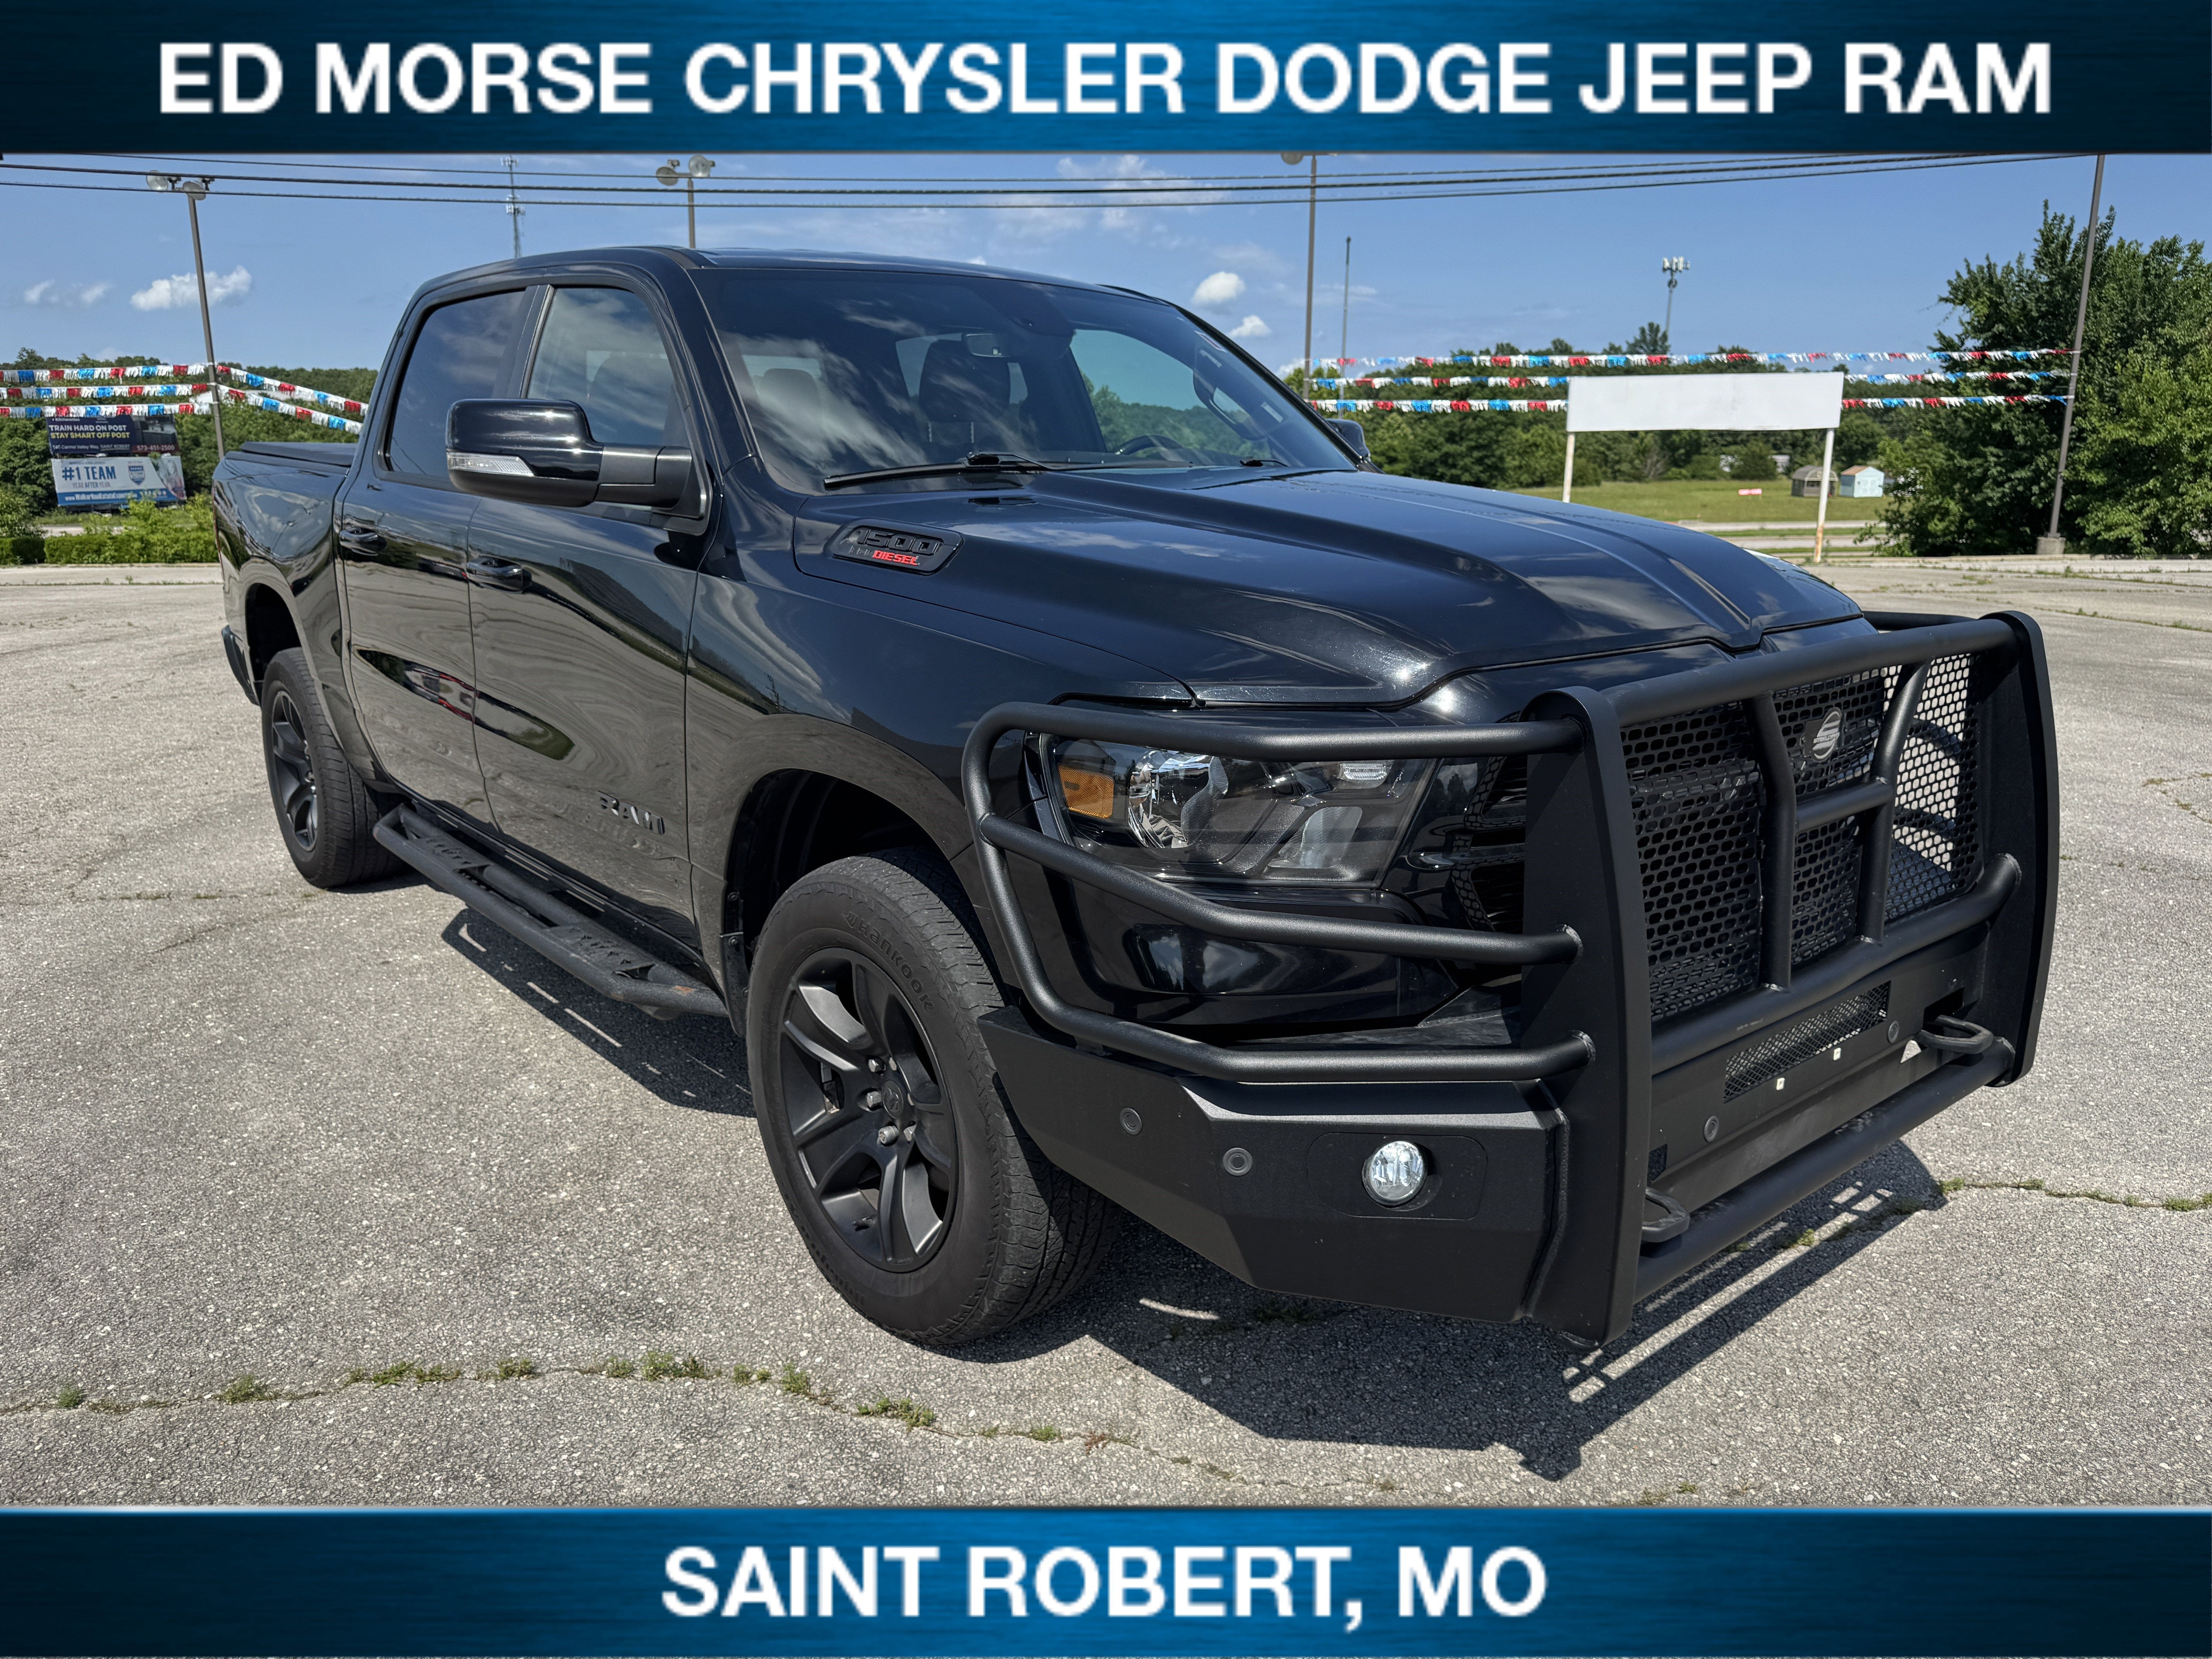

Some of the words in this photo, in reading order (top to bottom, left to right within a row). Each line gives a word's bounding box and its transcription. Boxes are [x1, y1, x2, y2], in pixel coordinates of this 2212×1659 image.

[62, 466, 81, 480] #1
[84, 466, 116, 480] TEAM
[848, 527, 942, 556] 1500
[596, 790, 666, 835] RAM
